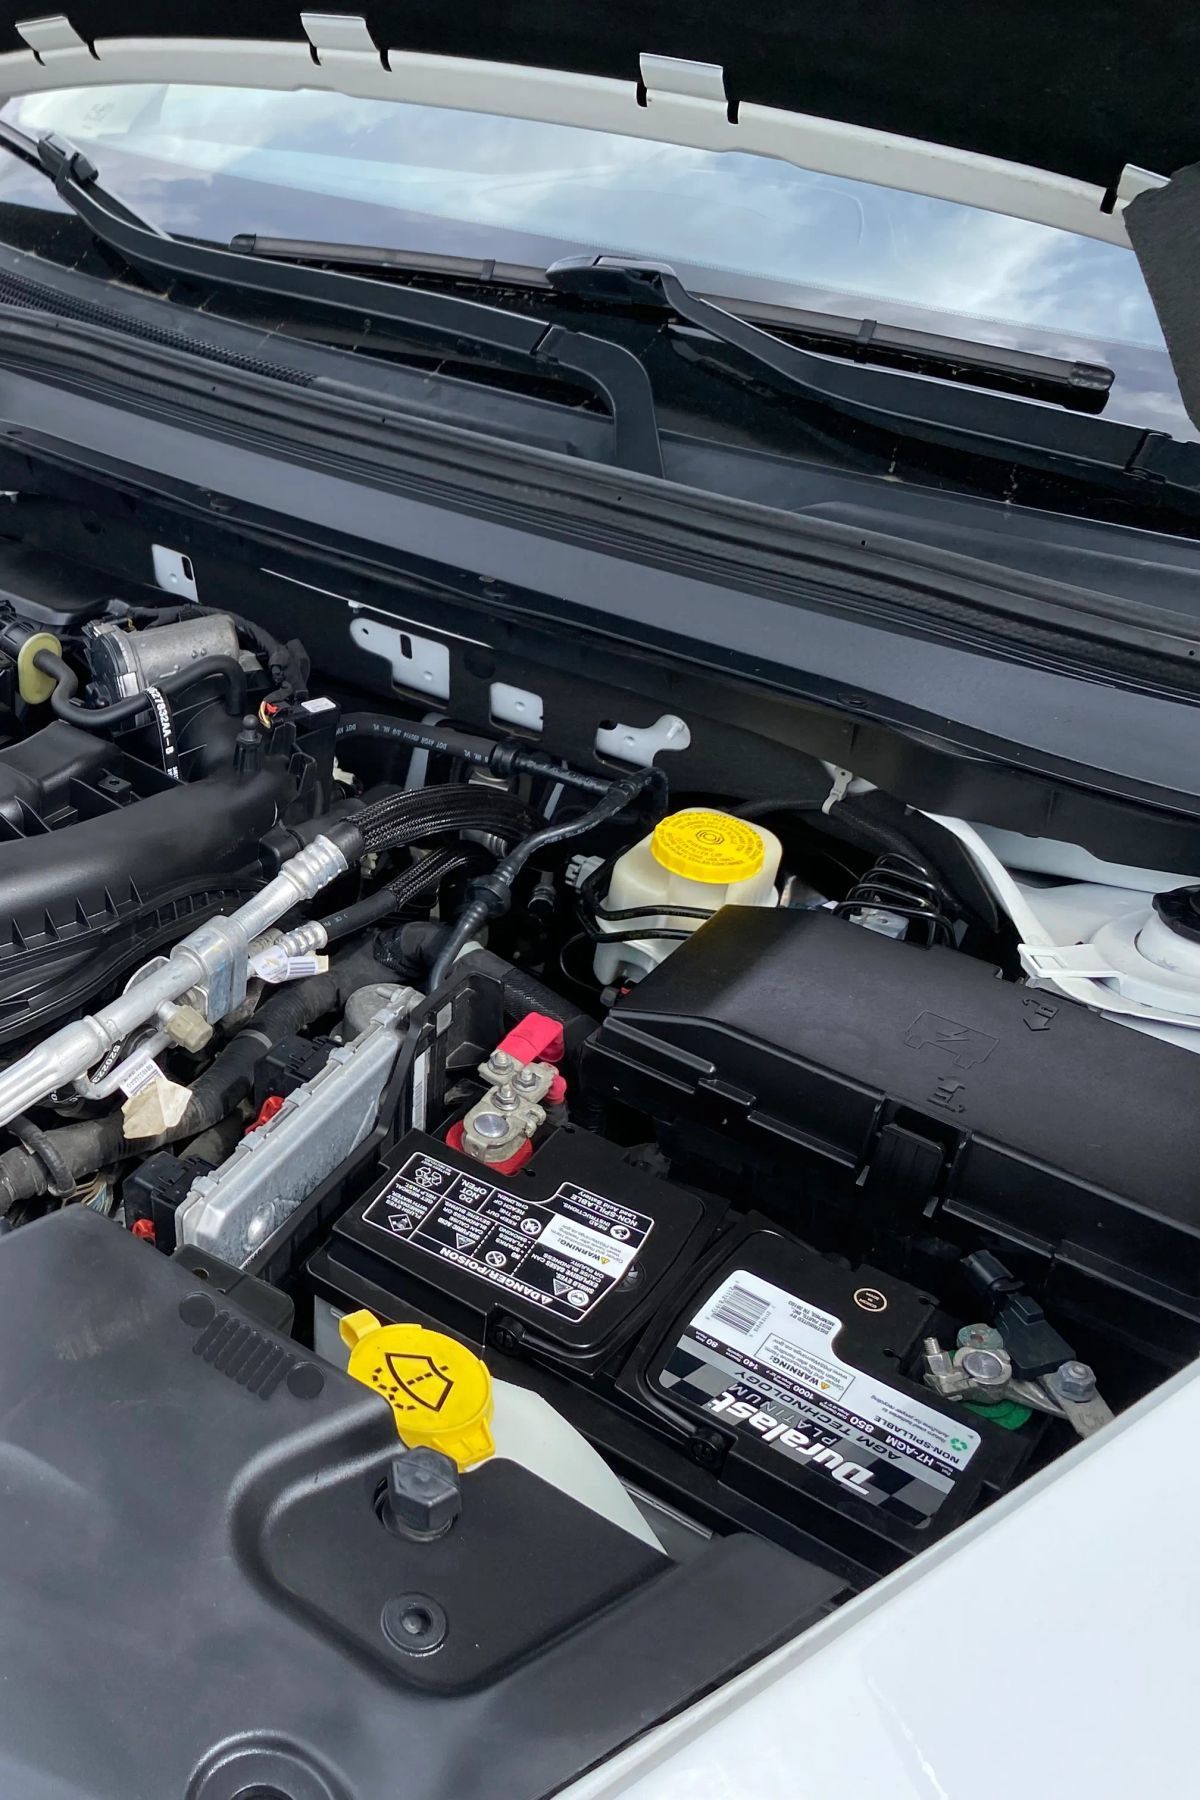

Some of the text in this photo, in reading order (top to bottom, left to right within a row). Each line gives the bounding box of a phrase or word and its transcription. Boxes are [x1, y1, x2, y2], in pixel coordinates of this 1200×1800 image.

[393, 1182, 434, 1204] GET MEDICAL
[403, 1181, 437, 1200] HELP FAST.
[458, 1178, 487, 1195] OPEN.
[458, 1186, 480, 1199] NOT
[386, 1193, 425, 1215] IMMEDIATELY
[411, 1200, 428, 1211] WITH
[457, 1193, 473, 1203] DO
[495, 1191, 529, 1210] CHILDREN.
[577, 1190, 637, 1220] Lead Acid Battery
[384, 1199, 422, 1219] FLUSH EYES
[442, 1206, 487, 1230] BLINDNESS OR
[465, 1210, 491, 1225] SEVERE
[485, 1208, 518, 1226] KEEP OUT
[498, 1207, 512, 1216] THE
[502, 1202, 525, 1215] REACH
[560, 1200, 610, 1227] INSTRUCTIONS.
[569, 1191, 638, 1228] NON-SPILLABLE
[436, 1216, 480, 1240] SULFURIC ACID
[448, 1215, 484, 1234] CAN CAUSE
[587, 1219, 607, 1231] READ
[497, 1226, 528, 1243] SMOKING
[497, 1232, 524, 1247] FLAMES
[494, 1237, 521, 1252] SPARKS
[556, 1236, 601, 1261] WARNING:
[509, 1251, 521, 1259] NO
[438, 1246, 542, 1300] DANGER/POISON
[530, 1253, 599, 1288] EXPLOSIVE GASES CAN
[541, 1252, 601, 1283] CAUSE BLINDNESS
[568, 1259, 605, 1278] OR INJURY.
[553, 1271, 595, 1294] SHIELD EYES.
[796, 1315, 828, 1336] DISTRIBUTED
[818, 1321, 832, 1331] BEST
[705, 1337, 719, 1348] 80
[741, 1357, 759, 1370] 140
[768, 1353, 820, 1386] WARNING:
[779, 1352, 813, 1375] Reproductive
[795, 1356, 808, 1366] after
[807, 1363, 825, 1375] hands
[824, 1372, 841, 1383] Wash
[791, 1383, 815, 1400] 1000
[727, 1380, 837, 1447] PLATINUM
[733, 1365, 902, 1463] AGM TECHNOLOGY
[707, 1386, 880, 1497] Duralast
[848, 1414, 934, 1466] H7-AGM 850
[872, 1412, 960, 1465] NON-SPILLABLE
